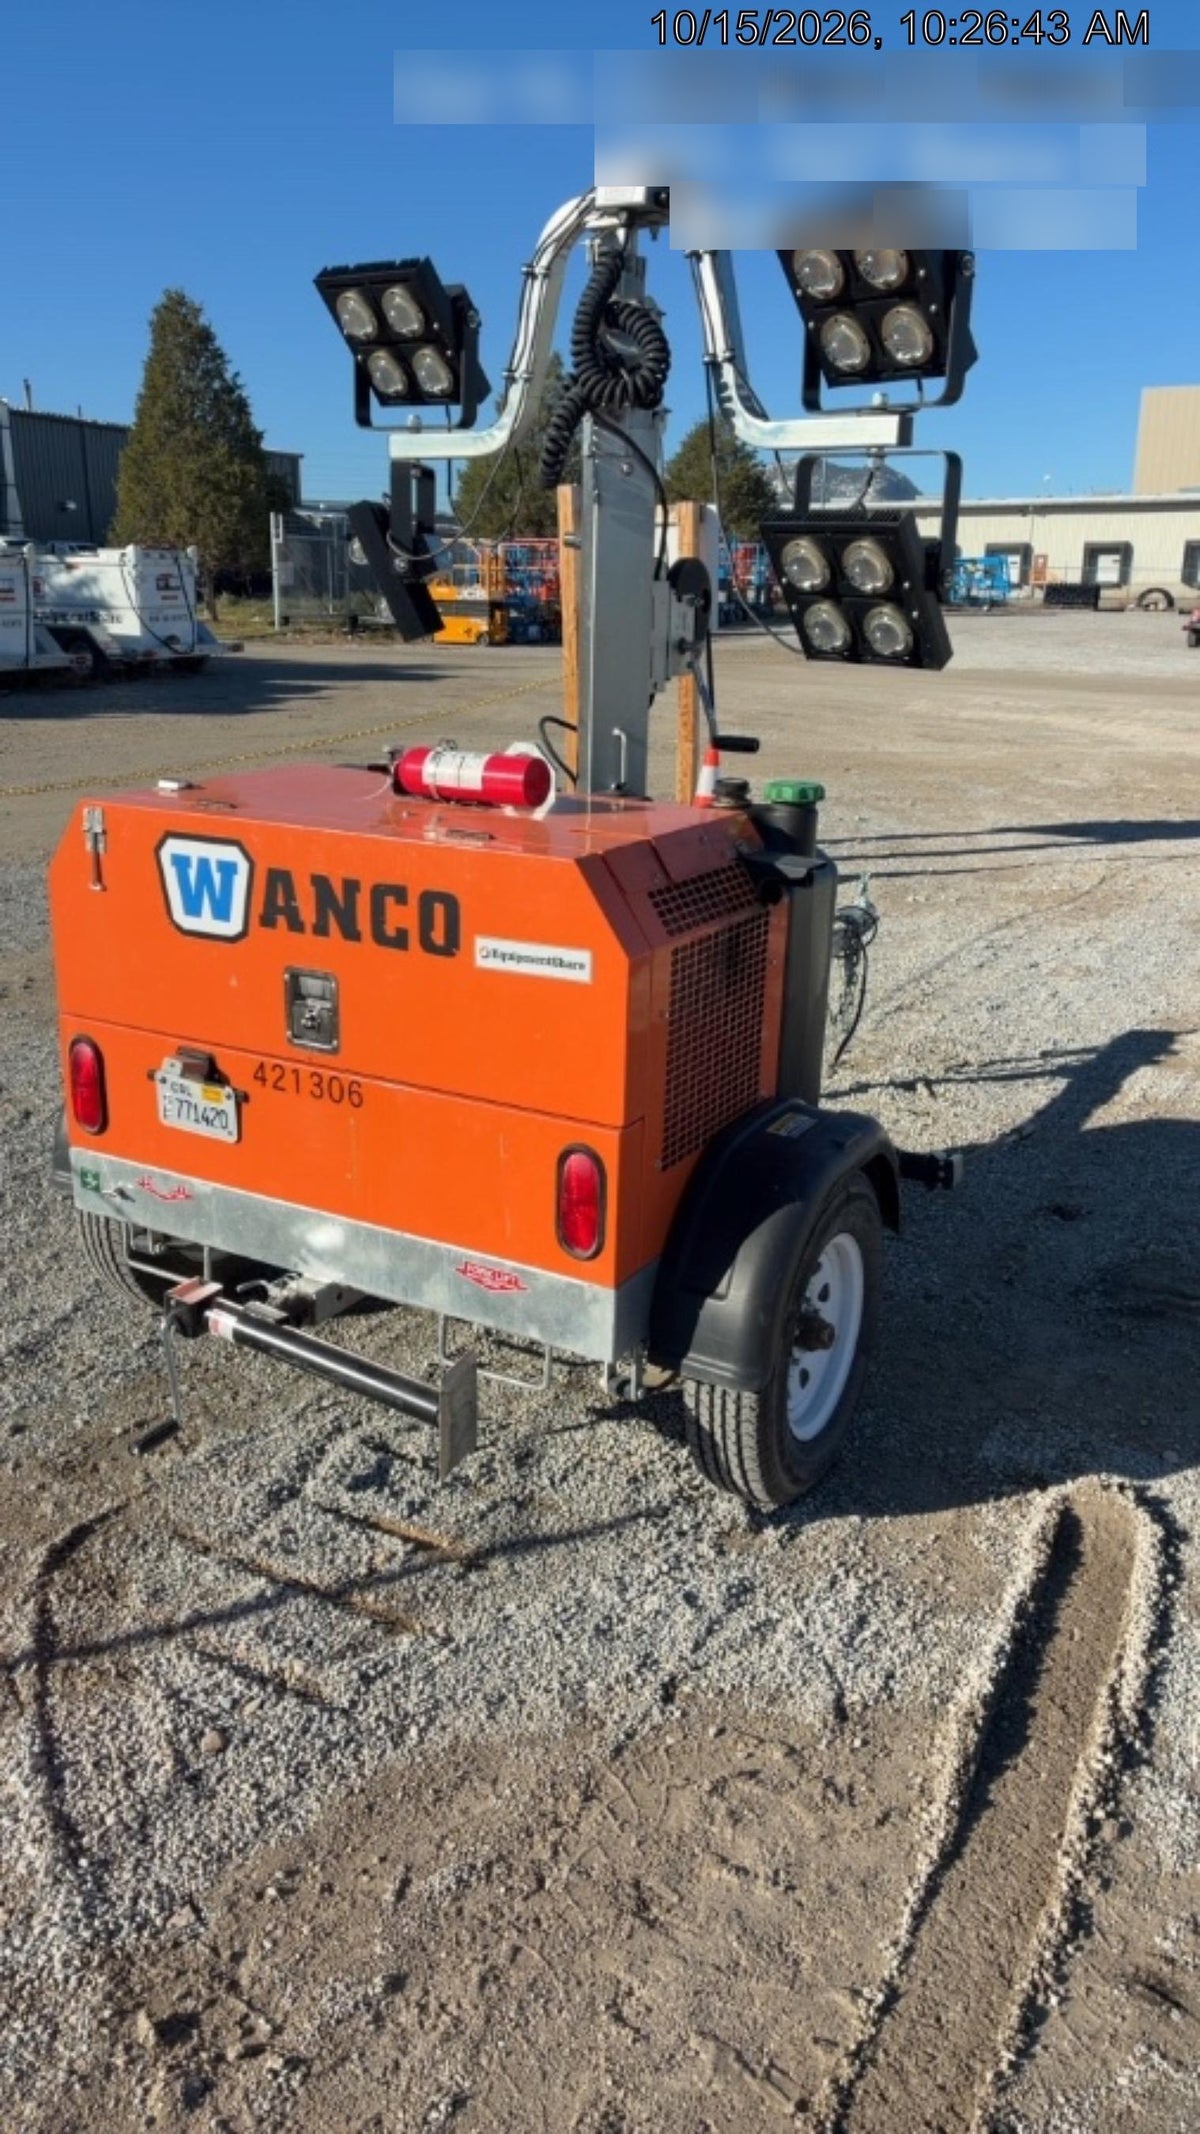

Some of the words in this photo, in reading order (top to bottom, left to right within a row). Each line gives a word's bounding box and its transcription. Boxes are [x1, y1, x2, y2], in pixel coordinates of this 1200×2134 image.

[170, 852, 461, 958] WANCO
[253, 1061, 364, 1109] 421306
[175, 1097, 229, 1130] 771420
